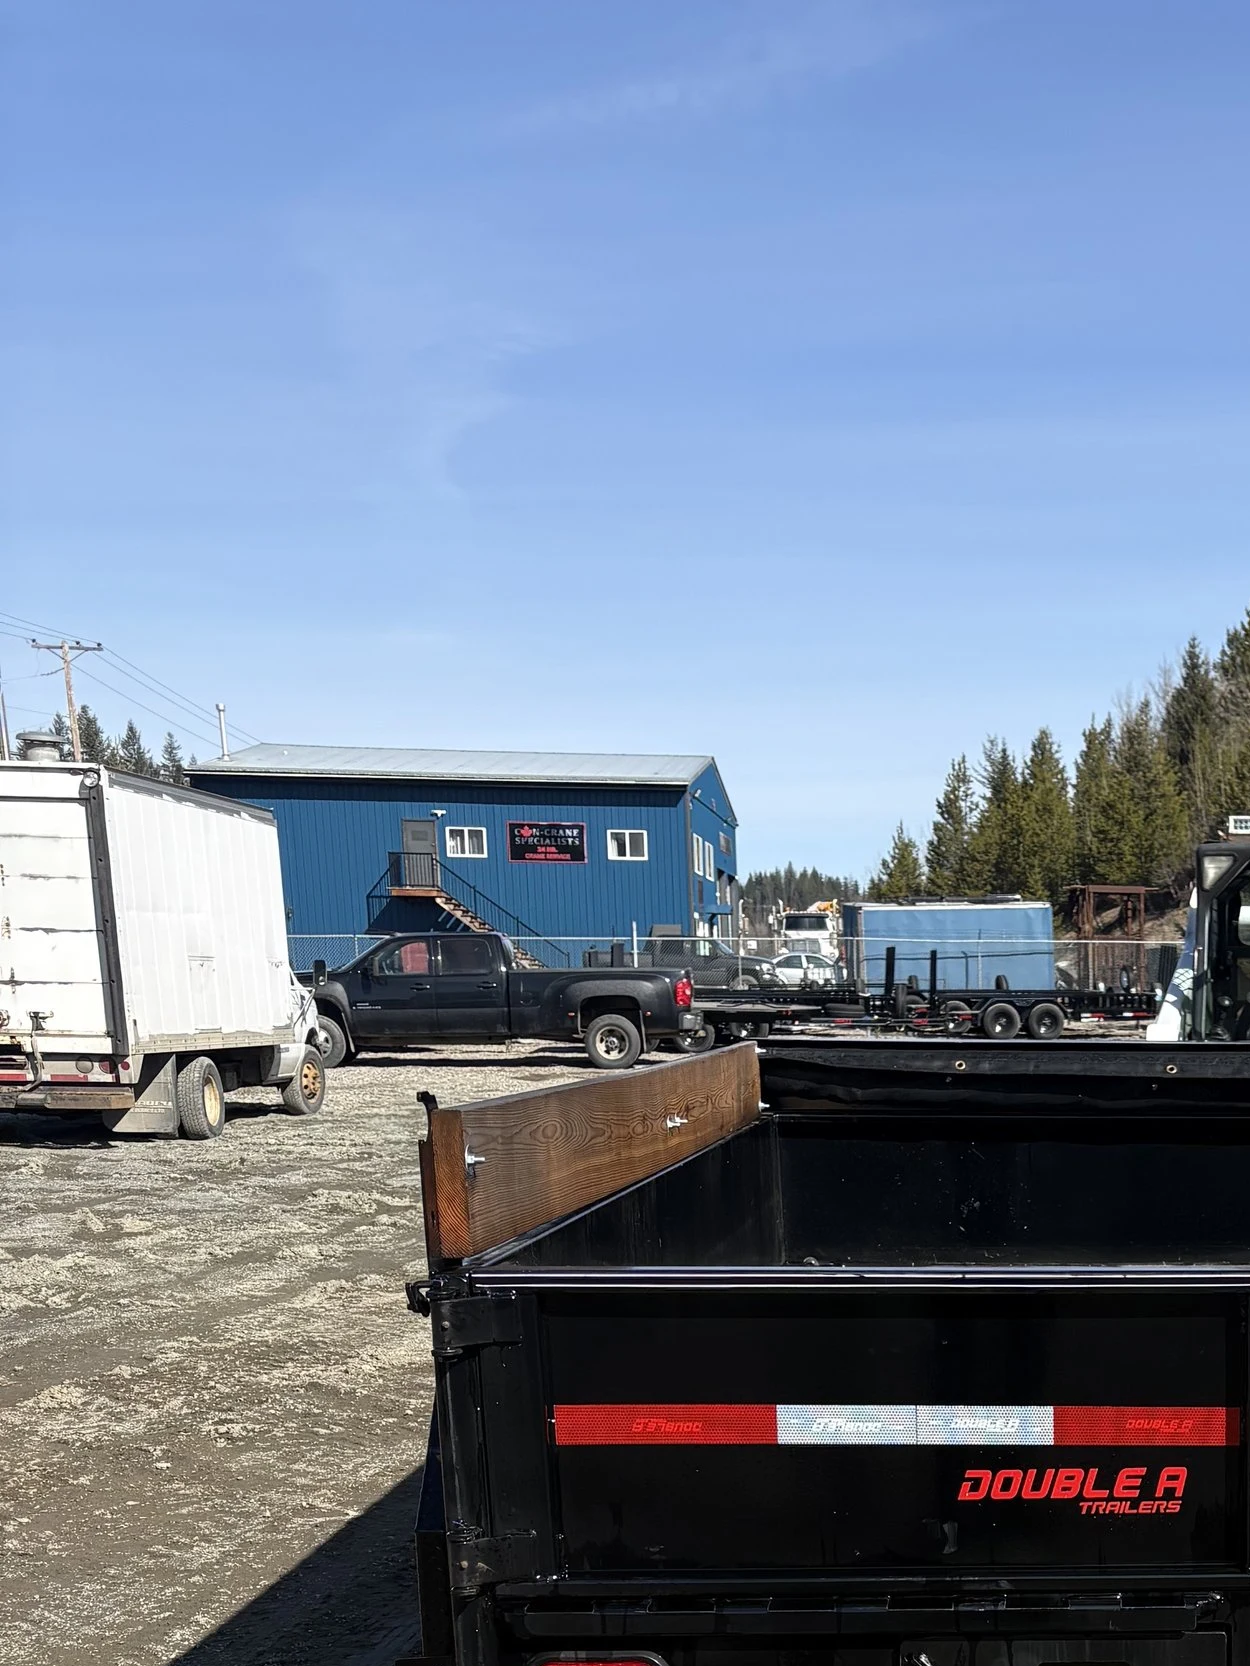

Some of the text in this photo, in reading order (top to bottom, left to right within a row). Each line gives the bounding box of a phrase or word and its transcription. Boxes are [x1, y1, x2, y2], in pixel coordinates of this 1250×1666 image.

[514, 827, 580, 837] CN-CRANE
[515, 837, 580, 846] SPECIALISTS
[648, 1421, 702, 1432] DOUBLE
[1126, 1420, 1179, 1429] DOUBLE
[958, 1466, 1188, 1500] DOUBLE A
[1079, 1500, 1182, 1515] TRAILERS
